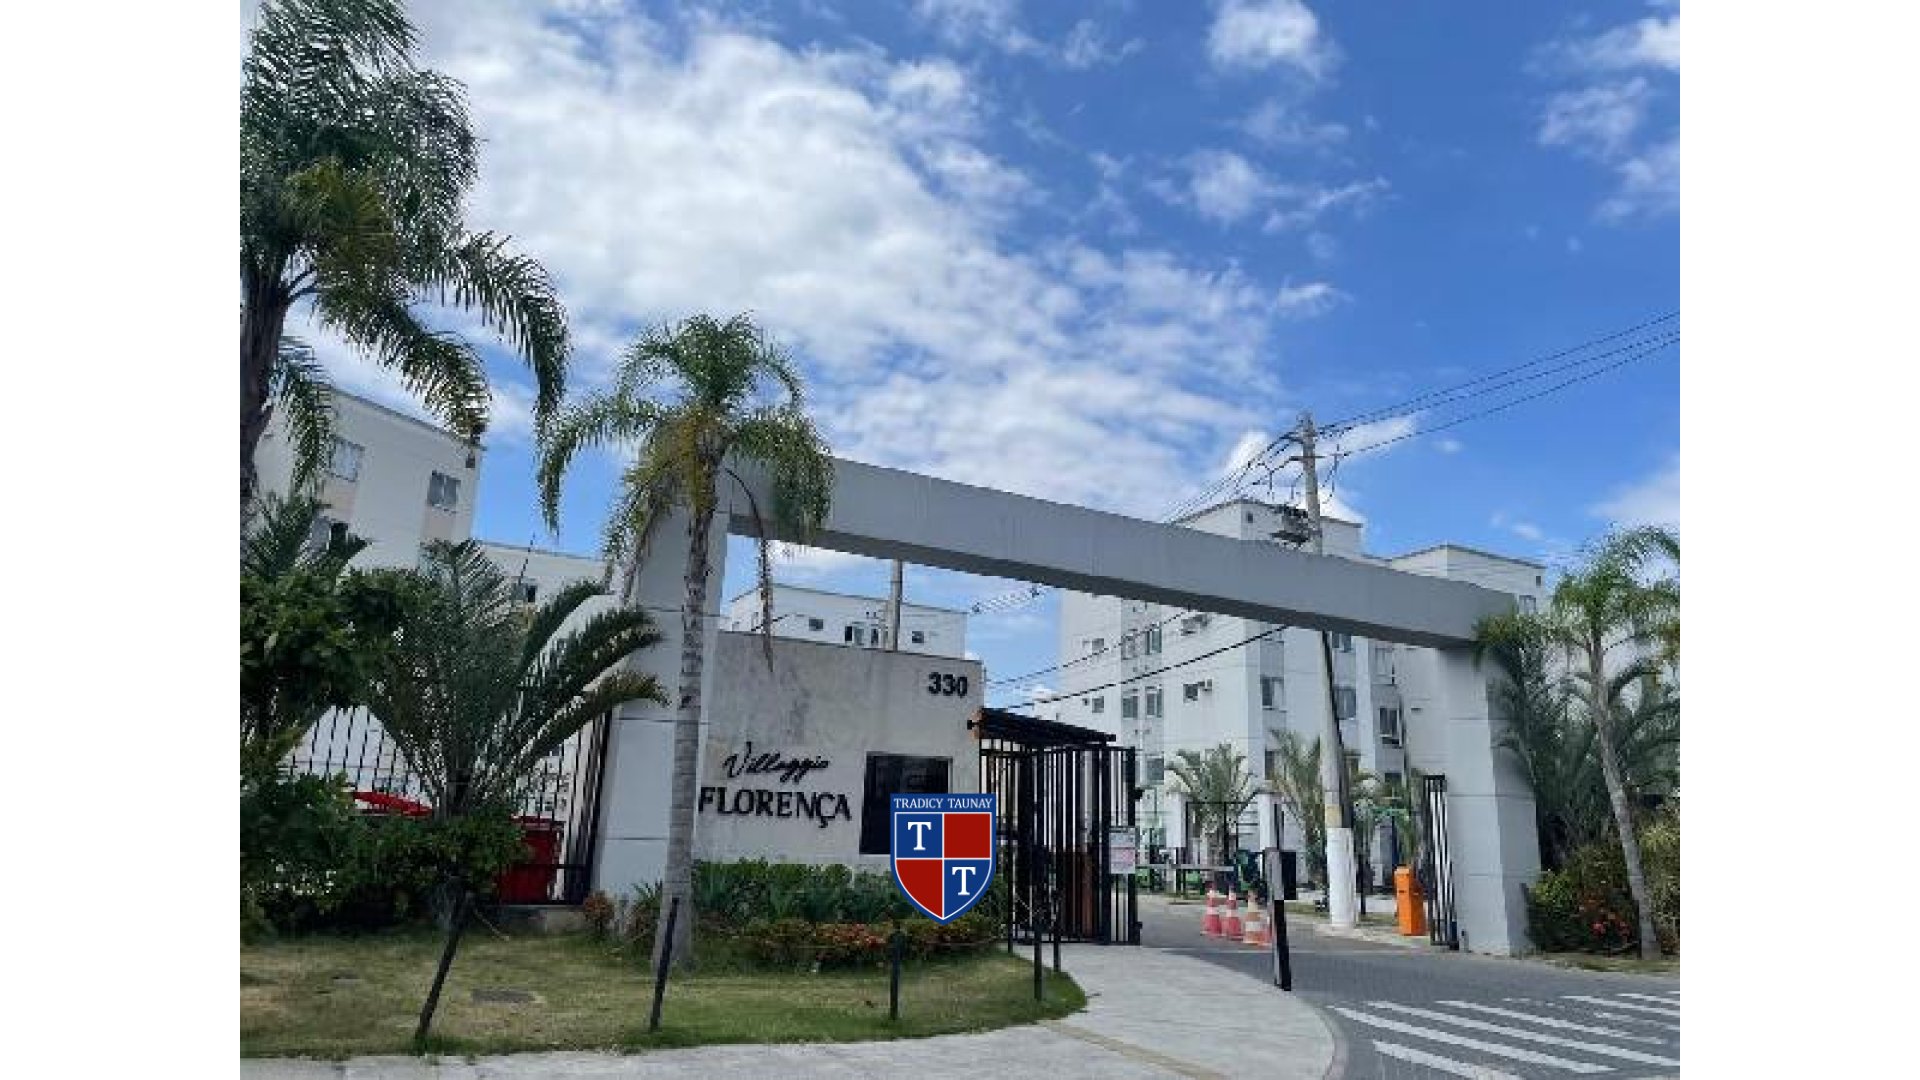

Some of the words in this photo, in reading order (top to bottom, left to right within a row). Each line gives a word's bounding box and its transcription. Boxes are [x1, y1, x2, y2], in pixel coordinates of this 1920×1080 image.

[928, 671, 969, 698] 330
[722, 741, 830, 784] Villaggio
[697, 786, 852, 829] FLORENÇA
